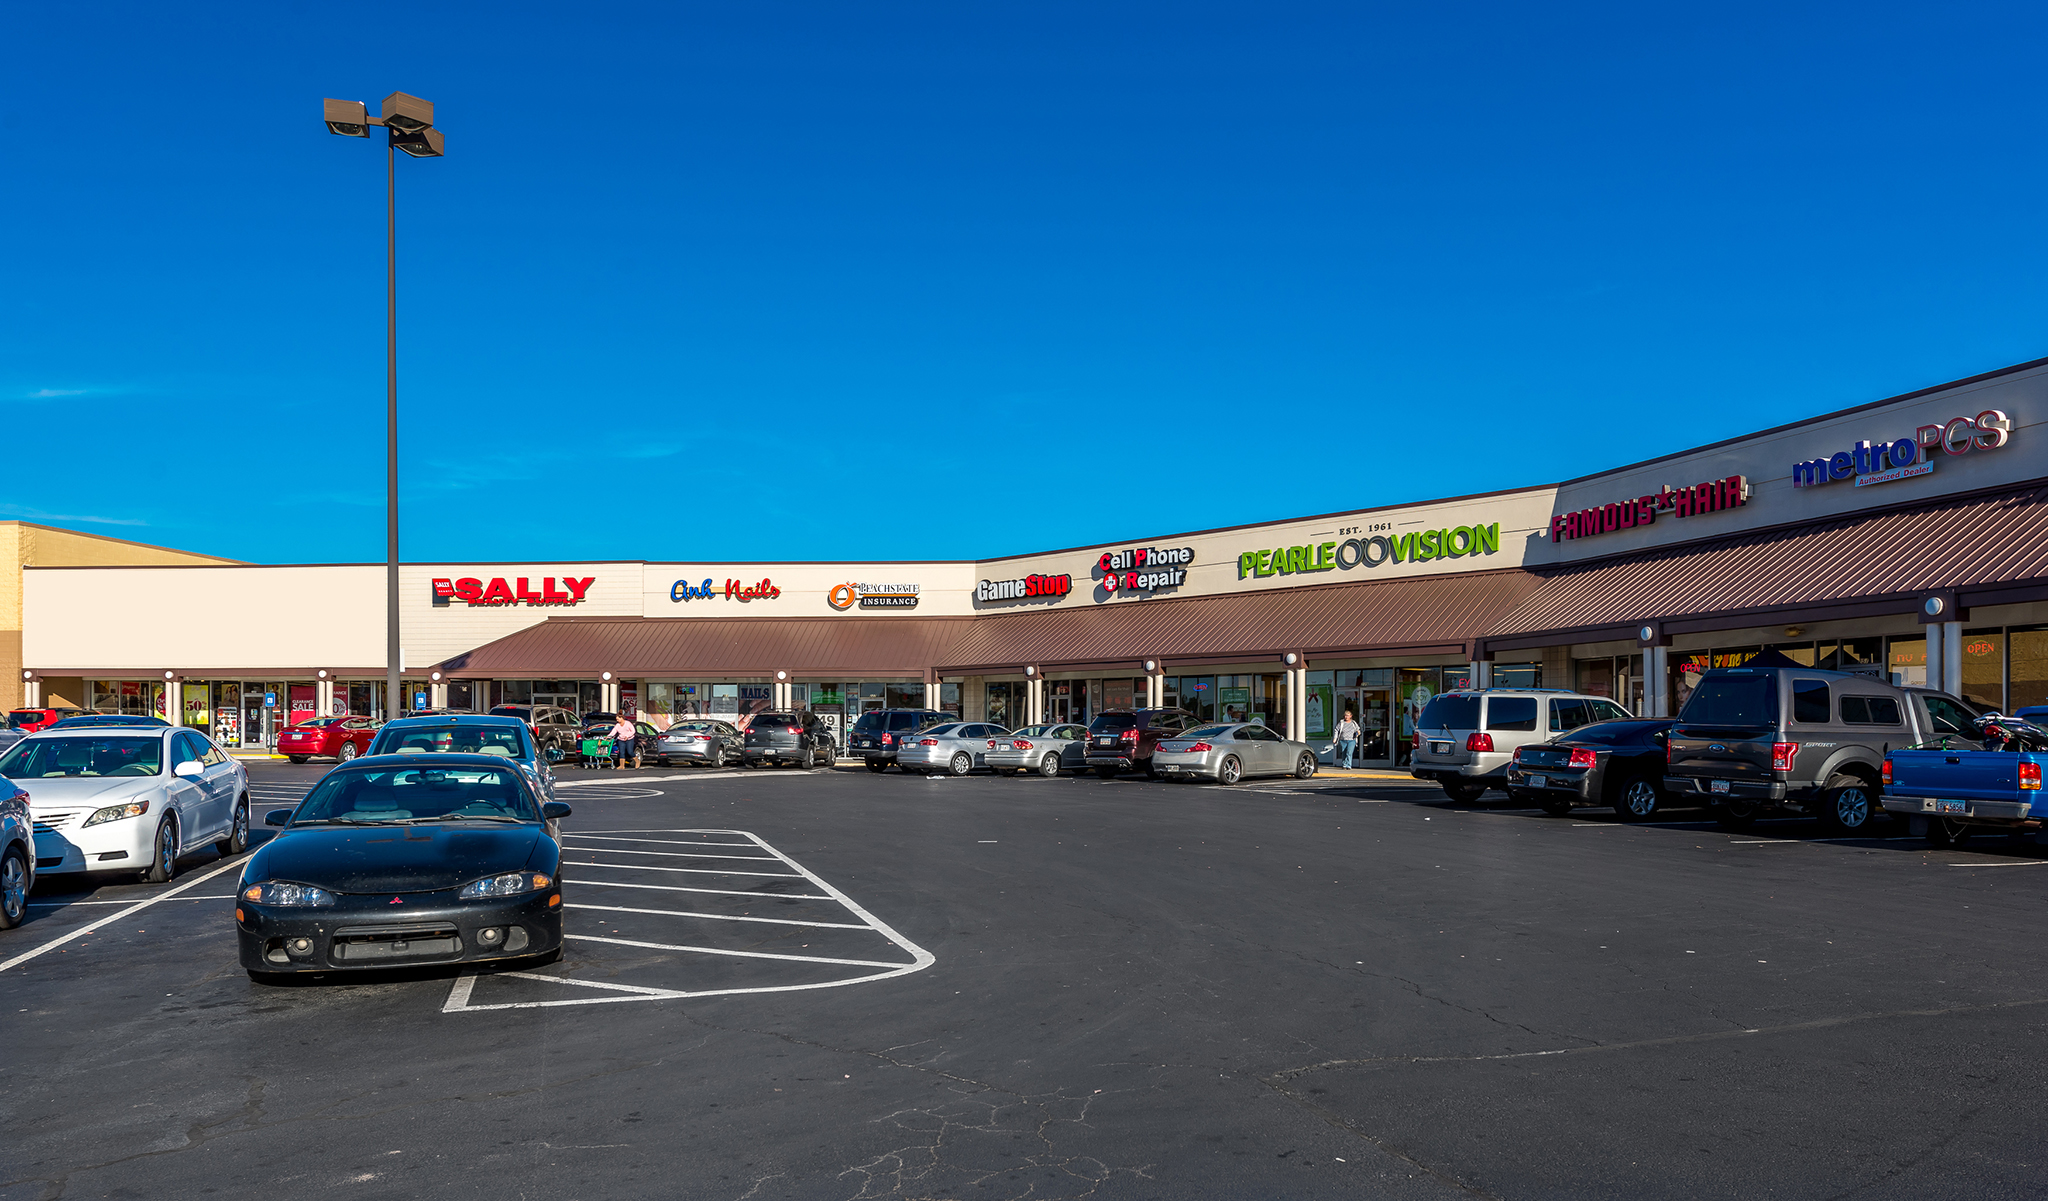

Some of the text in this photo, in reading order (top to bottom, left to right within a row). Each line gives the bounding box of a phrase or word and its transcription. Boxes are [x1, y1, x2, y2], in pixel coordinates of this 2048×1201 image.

[1793, 410, 2008, 488] metroPCS
[1858, 465, 1931, 486] Authorized Dealer
[1552, 475, 1746, 543] FAMOUS HAIR
[1339, 522, 1392, 535] EST. 1961
[1100, 548, 1190, 571] Cell Phone
[1241, 522, 1499, 577] PEARLE VISION
[454, 577, 596, 599] SALLY
[725, 578, 781, 601] Nails
[859, 582, 919, 594] PEACHSTATE
[976, 575, 1068, 601] GameStop
[1126, 568, 1182, 590] Repair
[1967, 643, 1995, 654] OPEN
[1680, 663, 1701, 673] OPEN
[677, 686, 695, 694] OPEN
[741, 687, 770, 700] NAILS
[292, 703, 314, 711] SALE
